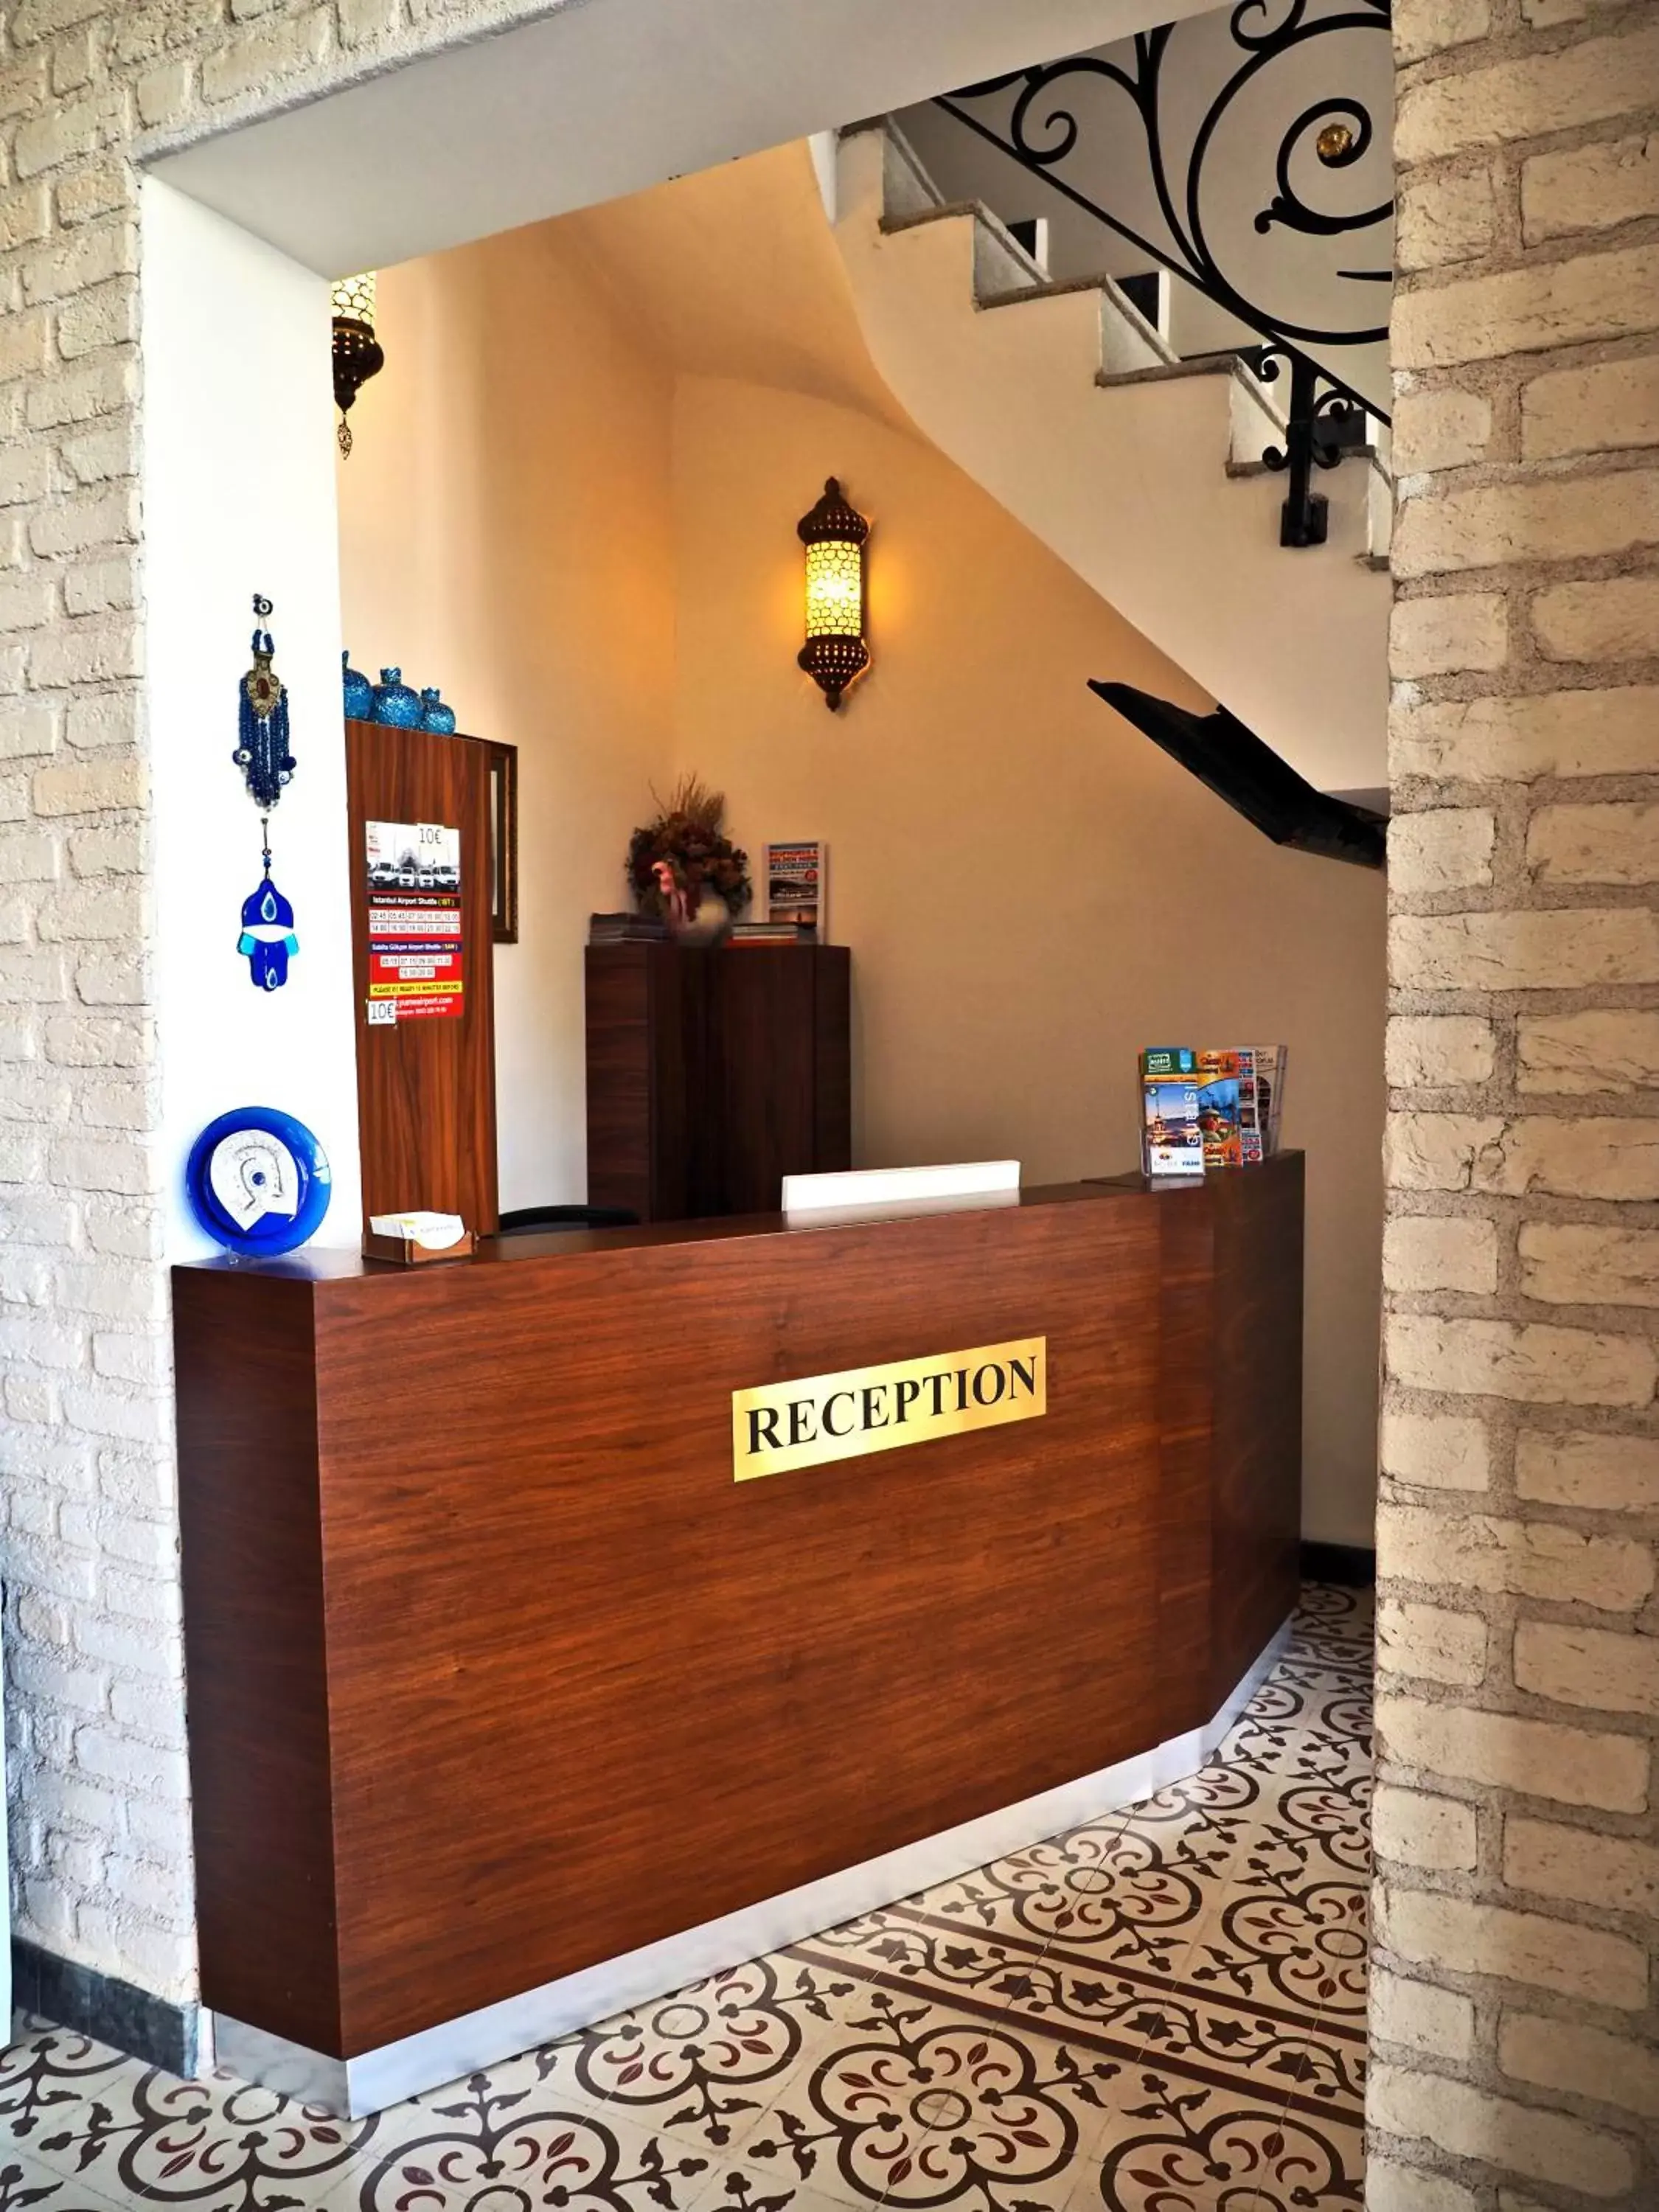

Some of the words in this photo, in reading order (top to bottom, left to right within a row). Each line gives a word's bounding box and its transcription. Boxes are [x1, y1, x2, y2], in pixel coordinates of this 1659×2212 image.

[420, 828, 442, 844] 10€
[371, 1002, 394, 1020] 10€
[745, 1356, 1037, 1455] RECEPTION
